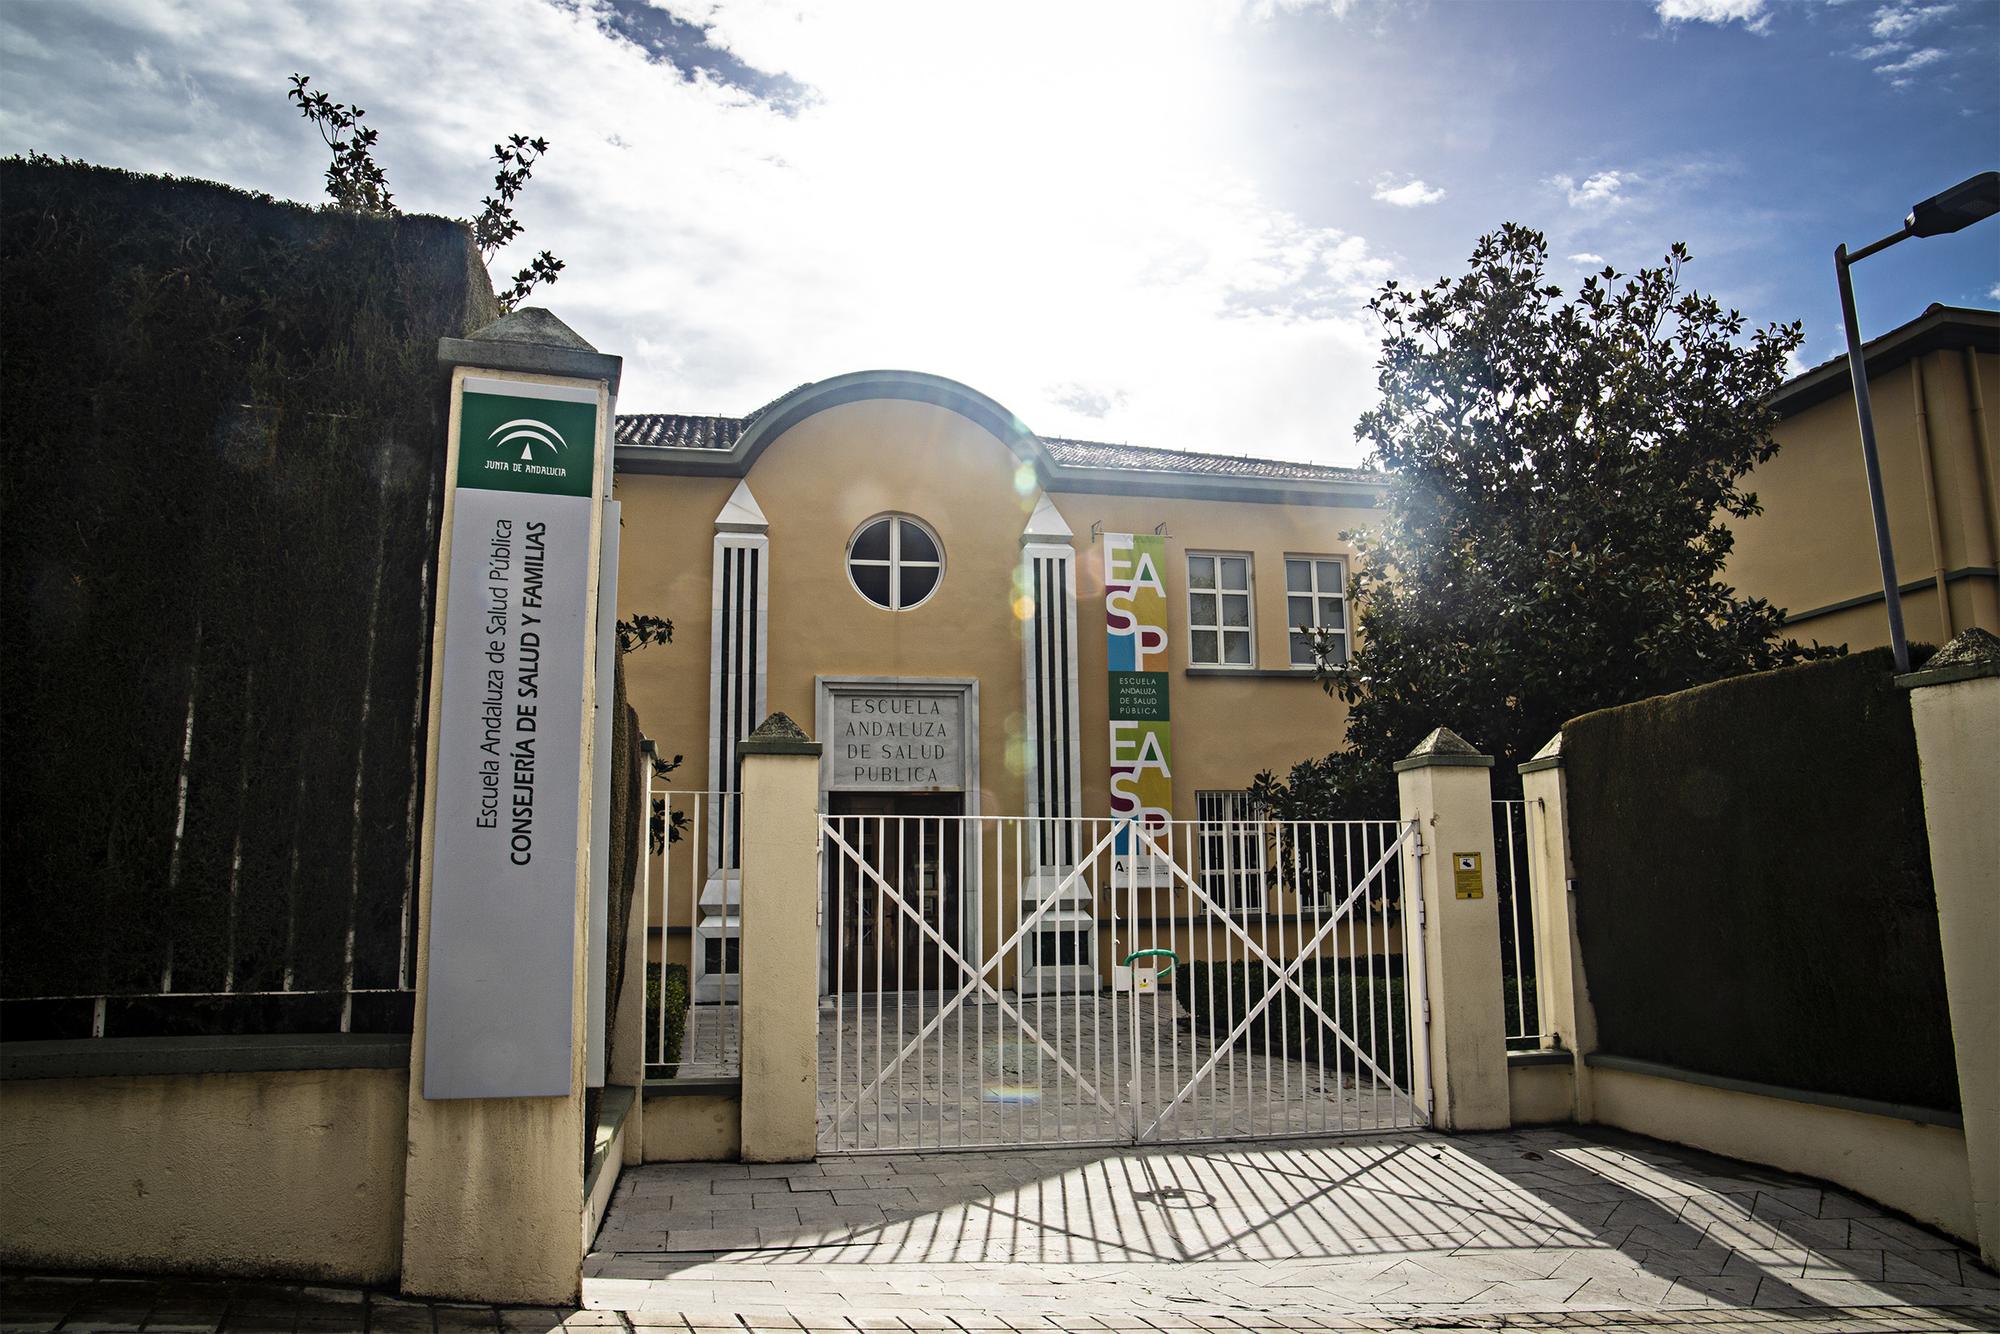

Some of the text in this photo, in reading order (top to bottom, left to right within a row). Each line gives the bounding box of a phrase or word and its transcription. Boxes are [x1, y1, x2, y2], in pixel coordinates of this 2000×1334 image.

[484, 460, 509, 471] JUNTA
[512, 463, 523, 473] DE
[476, 519, 512, 828] Escuela Andaluza de Salud Pública
[1119, 677, 1157, 685] ESCUELA
[510, 521, 546, 866] CONSEJERÍA DE SALUD Y FAMILIAS
[1120, 687, 1157, 695] ANDALUZA
[851, 698, 940, 715] ESCUELA
[1119, 697, 1158, 705] DE SALUD
[1119, 705, 1158, 715] PÚBLICA
[845, 721, 947, 737] ANDALUZA
[847, 743, 945, 760] DE SALUD
[854, 766, 938, 782] PUBLICA
